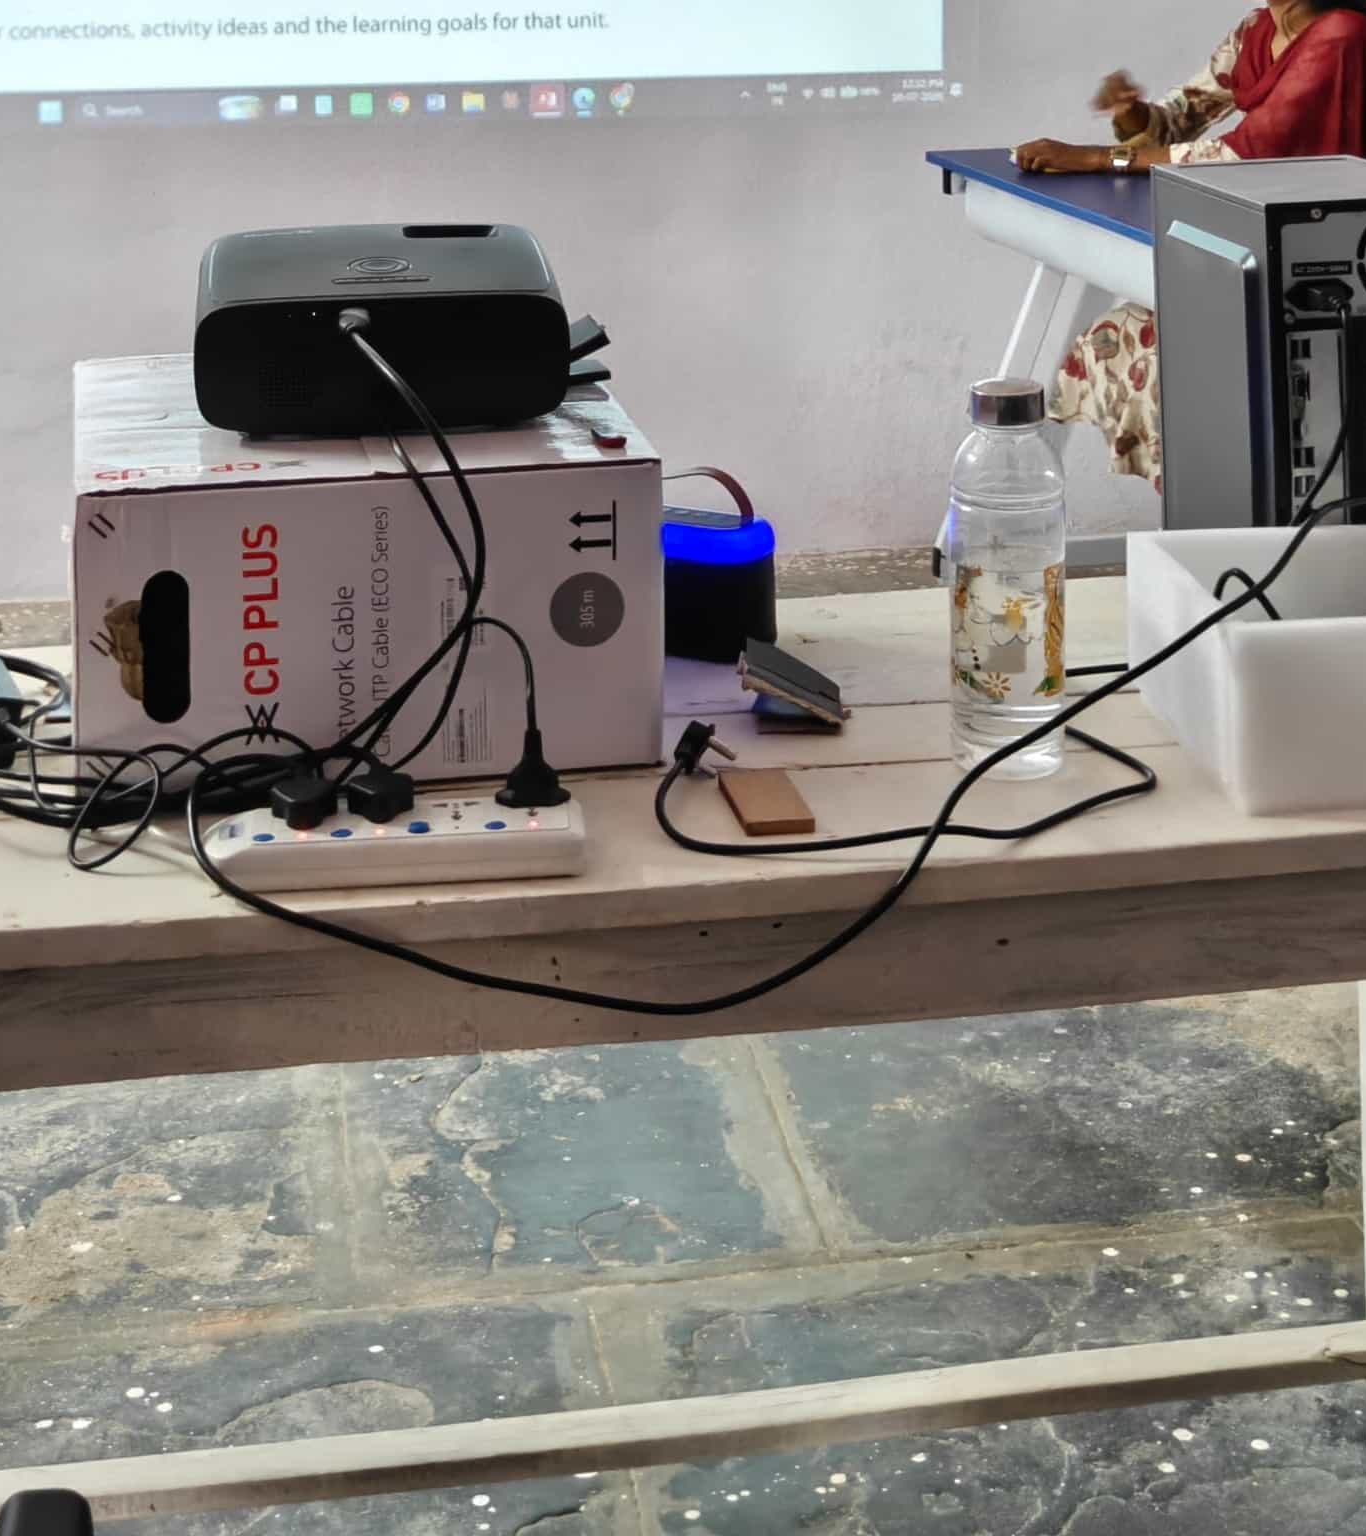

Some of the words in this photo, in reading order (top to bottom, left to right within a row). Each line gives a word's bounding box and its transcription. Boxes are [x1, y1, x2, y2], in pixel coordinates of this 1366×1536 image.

[7, 21, 136, 41] connections,
[140, 19, 213, 41] activity
[217, 17, 269, 38] ideas
[272, 15, 311, 36] and
[314, 15, 348, 35] the
[352, 15, 432, 37] learning
[436, 12, 489, 37] goals
[492, 11, 519, 31] for
[523, 11, 562, 31] that
[566, 11, 609, 30] unit.
[370, 505, 392, 562] Series)
[241, 523, 280, 631] PLUS
[371, 567, 393, 612] (ECO
[582, 589, 596, 601] m
[331, 585, 357, 653] Cable
[371, 616, 391, 670] Cable
[579, 605, 596, 630] 305
[243, 641, 280, 696] CP
